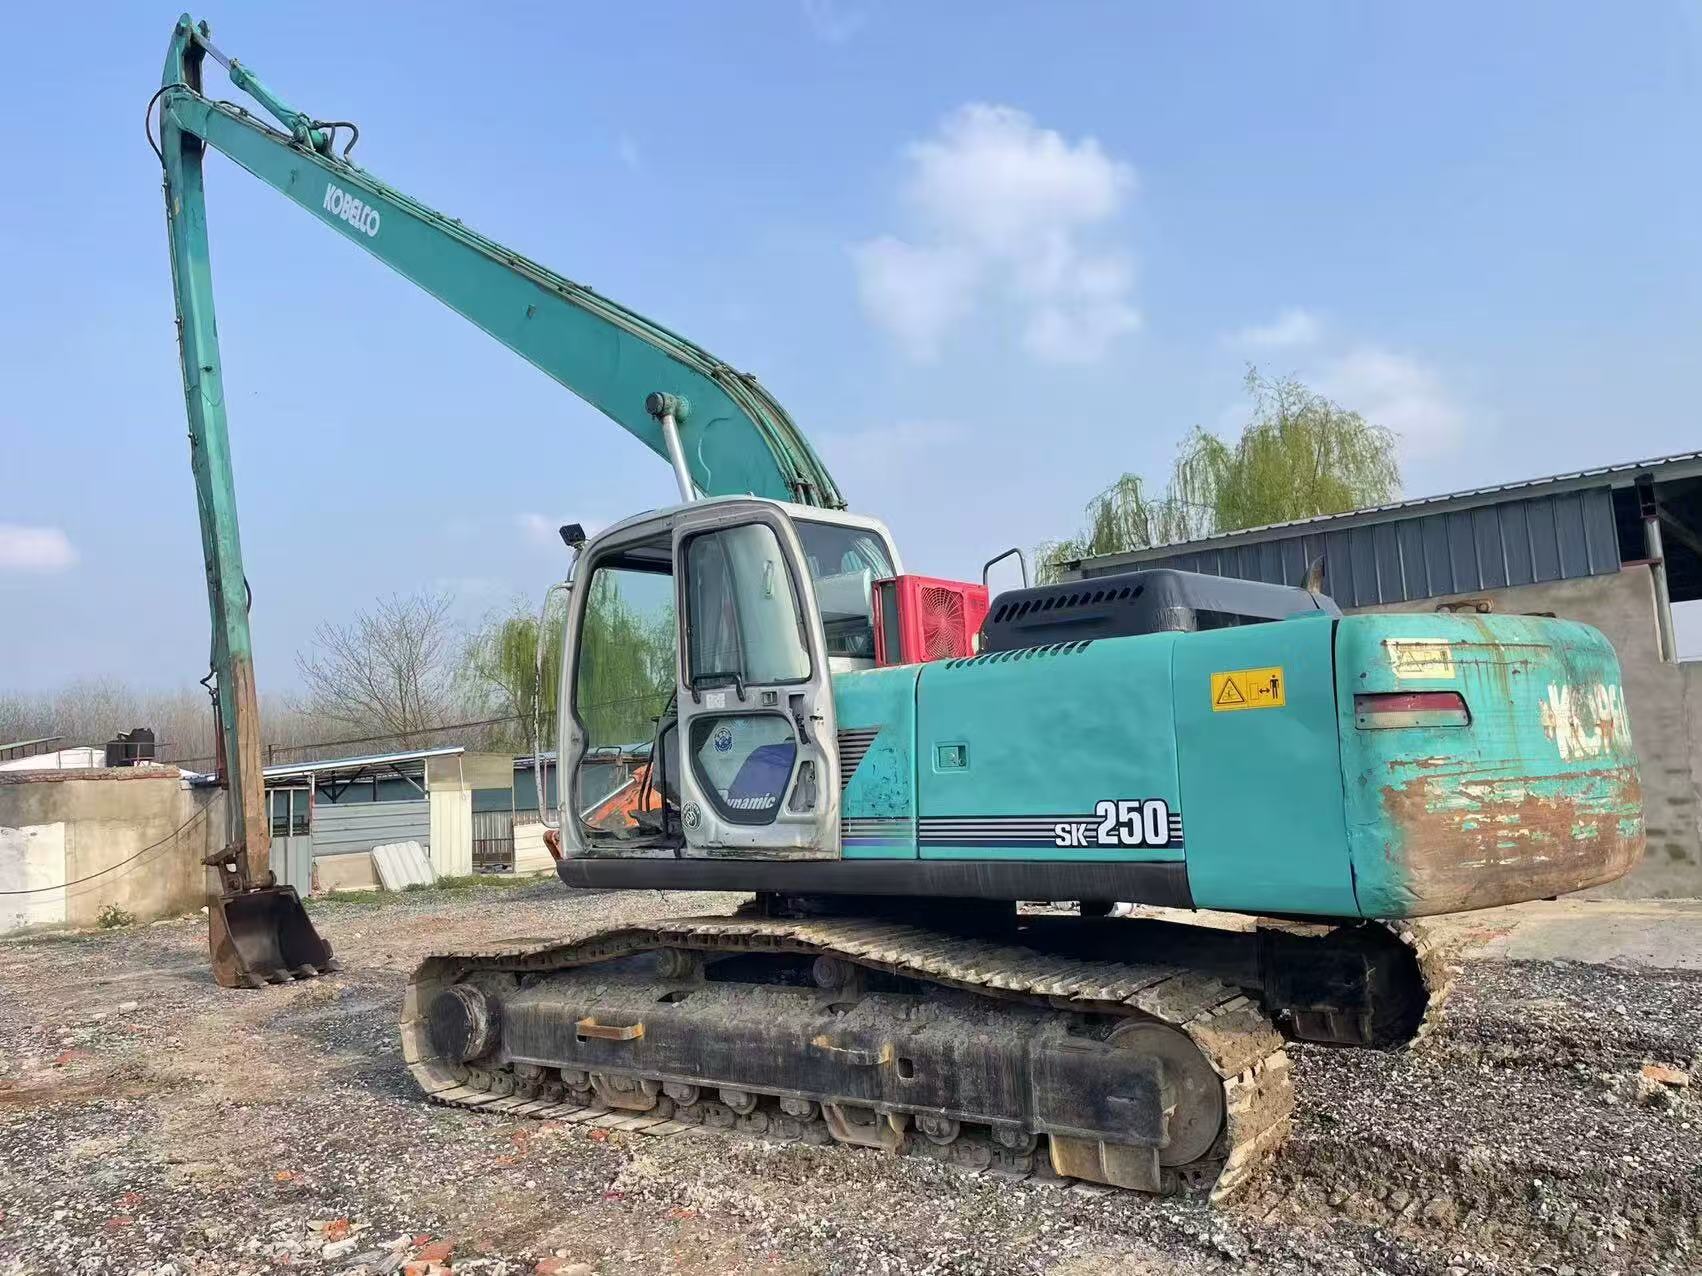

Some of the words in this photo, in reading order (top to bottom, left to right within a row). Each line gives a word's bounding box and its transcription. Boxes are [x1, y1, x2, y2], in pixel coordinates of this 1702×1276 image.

[323, 183, 380, 237] KOBELCO
[1055, 823, 1088, 847] SK
[1095, 799, 1169, 846] 250
